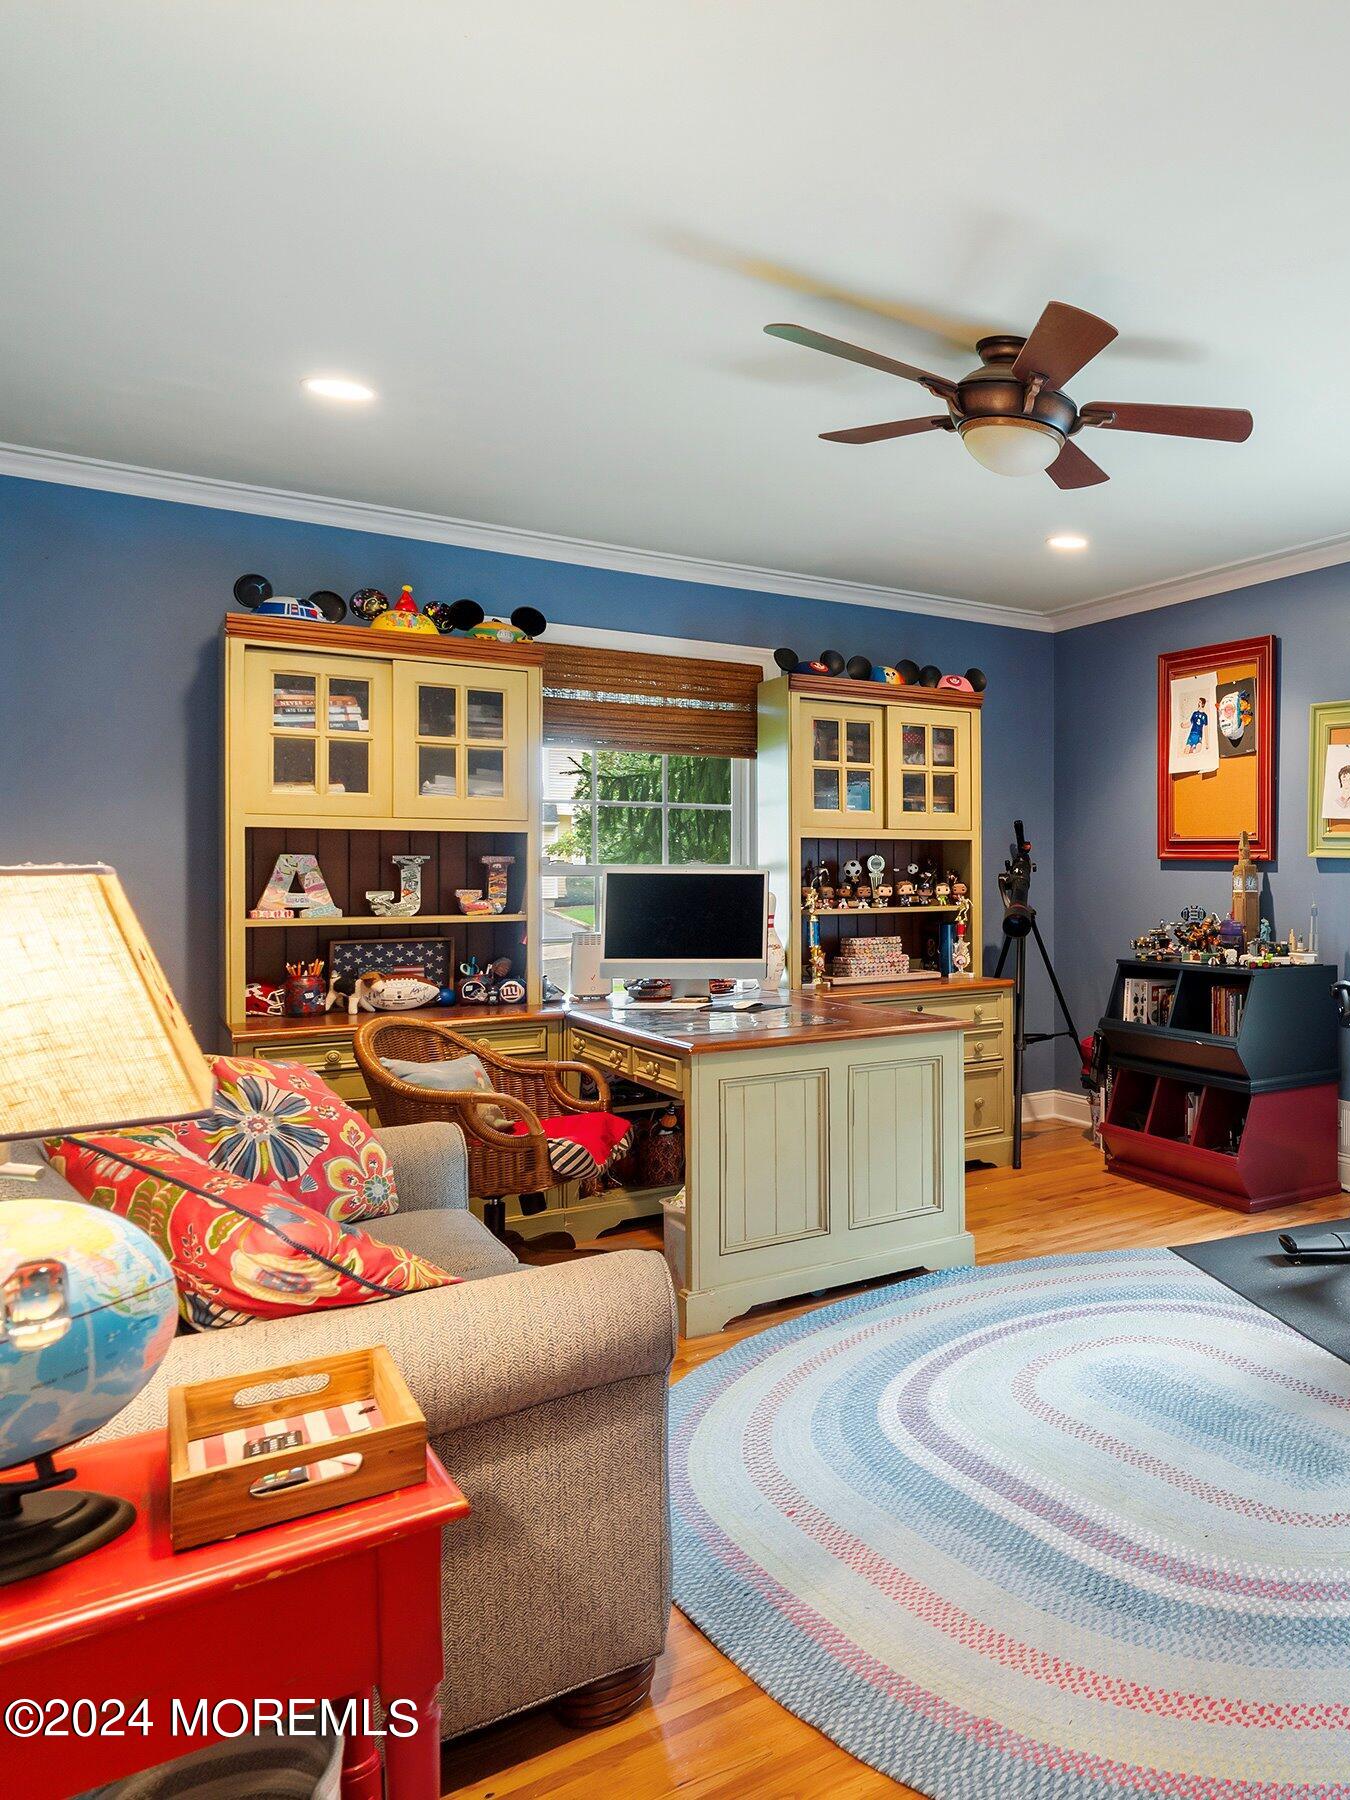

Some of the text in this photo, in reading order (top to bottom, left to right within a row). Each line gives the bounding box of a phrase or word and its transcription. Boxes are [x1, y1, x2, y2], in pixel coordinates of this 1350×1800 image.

[250, 854, 515, 918] A J J
